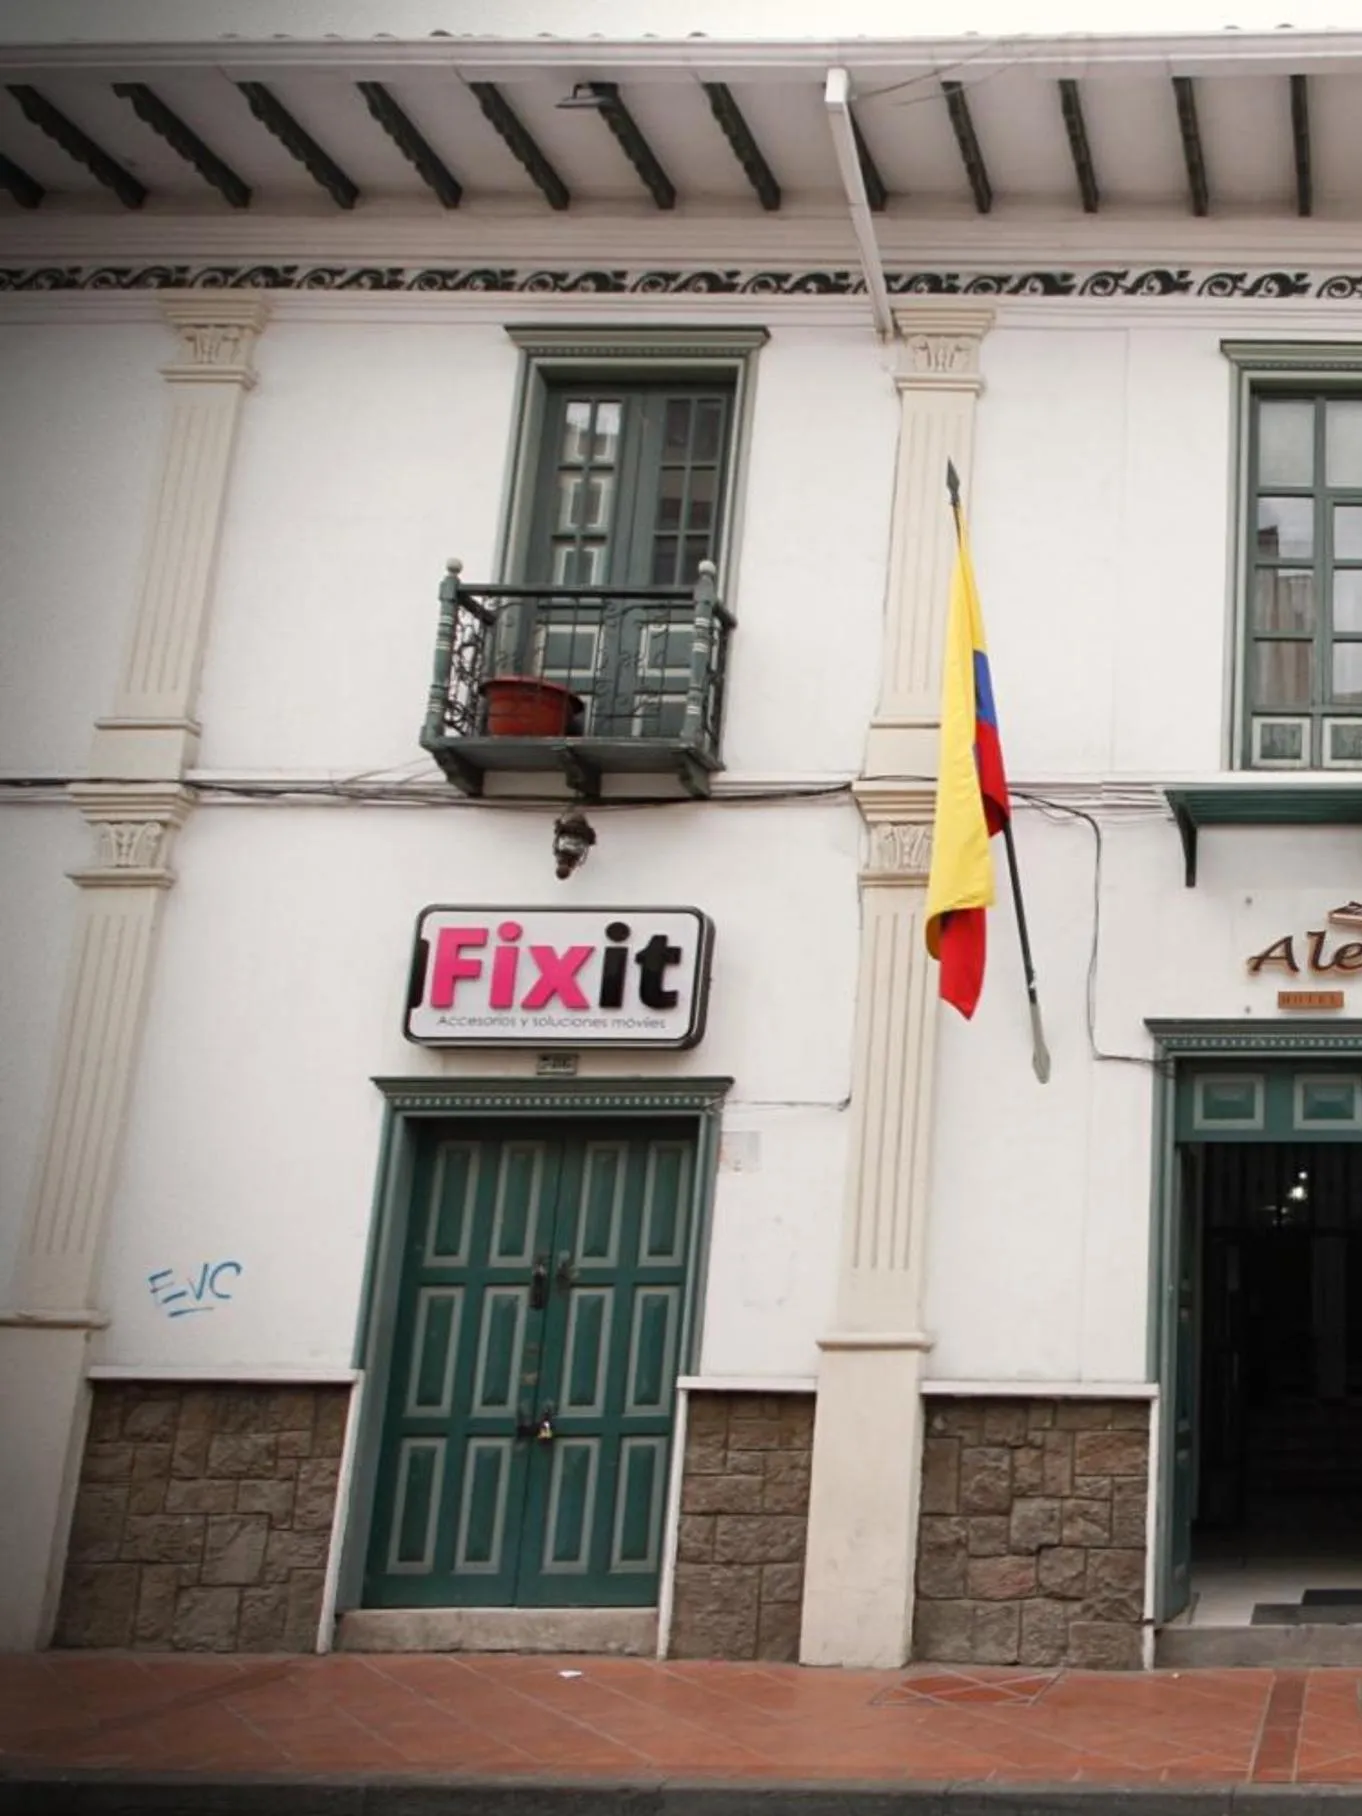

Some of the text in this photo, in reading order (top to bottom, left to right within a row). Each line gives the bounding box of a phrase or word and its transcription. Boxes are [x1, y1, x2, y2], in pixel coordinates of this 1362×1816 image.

[429, 921, 682, 1010] Fixit
[436, 1015, 516, 1028] Accesorios
[532, 1015, 607, 1029] soluciones
